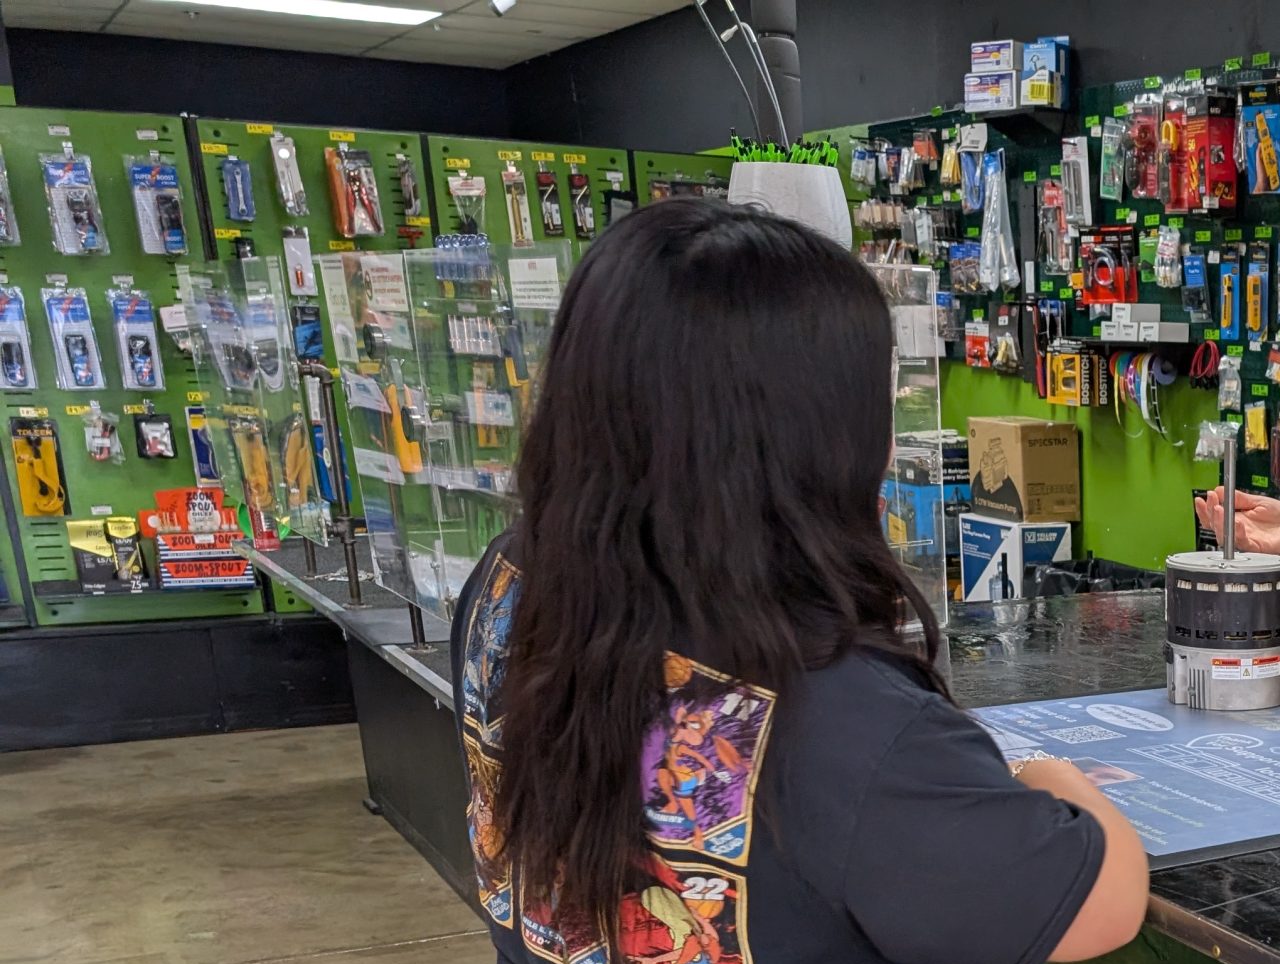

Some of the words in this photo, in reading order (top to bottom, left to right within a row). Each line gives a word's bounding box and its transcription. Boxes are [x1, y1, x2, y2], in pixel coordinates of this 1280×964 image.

[1081, 354, 1090, 404] BOSTITCH
[1100, 355, 1108, 404] BOSTITCH
[1028, 437, 1069, 448] SPECSTAR
[186, 492, 214, 501] ZOOM
[187, 502, 217, 511] SPOUT
[174, 562, 242, 574] ZOOM-SPOUT
[681, 876, 729, 900] 22
